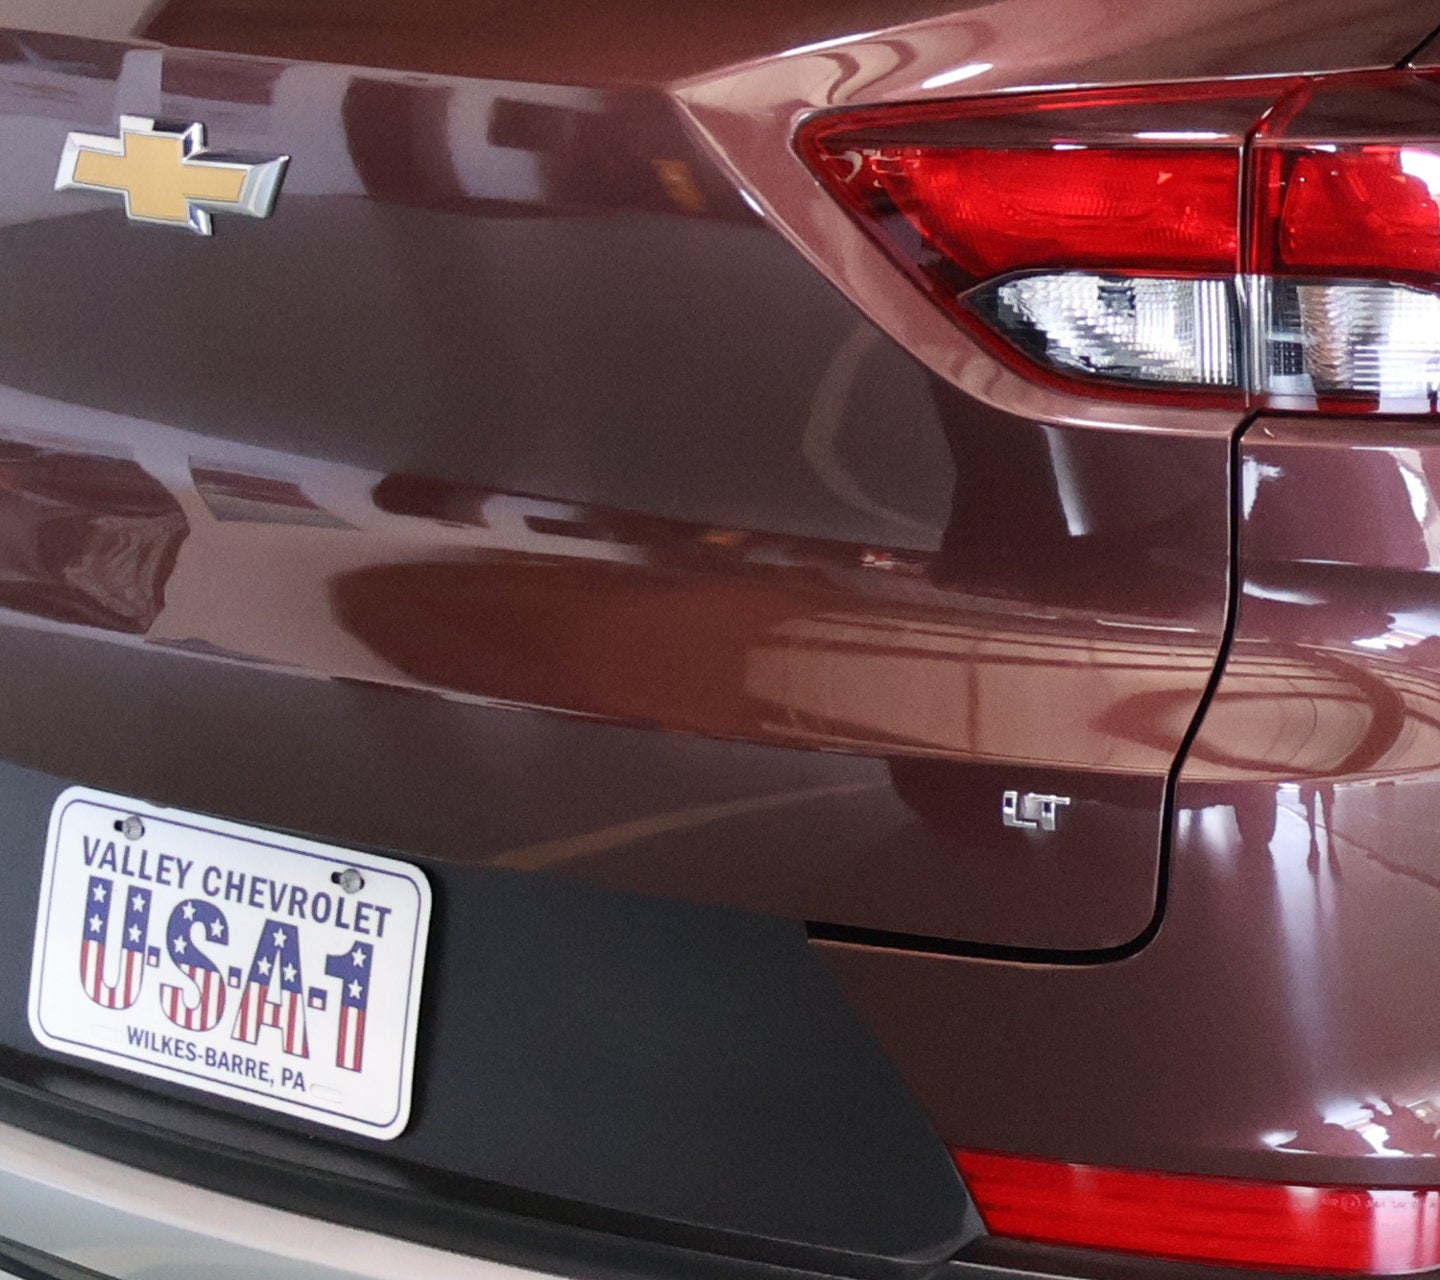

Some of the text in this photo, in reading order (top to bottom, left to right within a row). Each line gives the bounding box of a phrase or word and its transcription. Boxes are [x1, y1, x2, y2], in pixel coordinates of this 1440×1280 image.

[1002, 790, 1071, 831] LT
[81, 835, 392, 938] VALLEY CHEVROLET
[127, 1025, 307, 1093] WILKES-BARRE, PA
